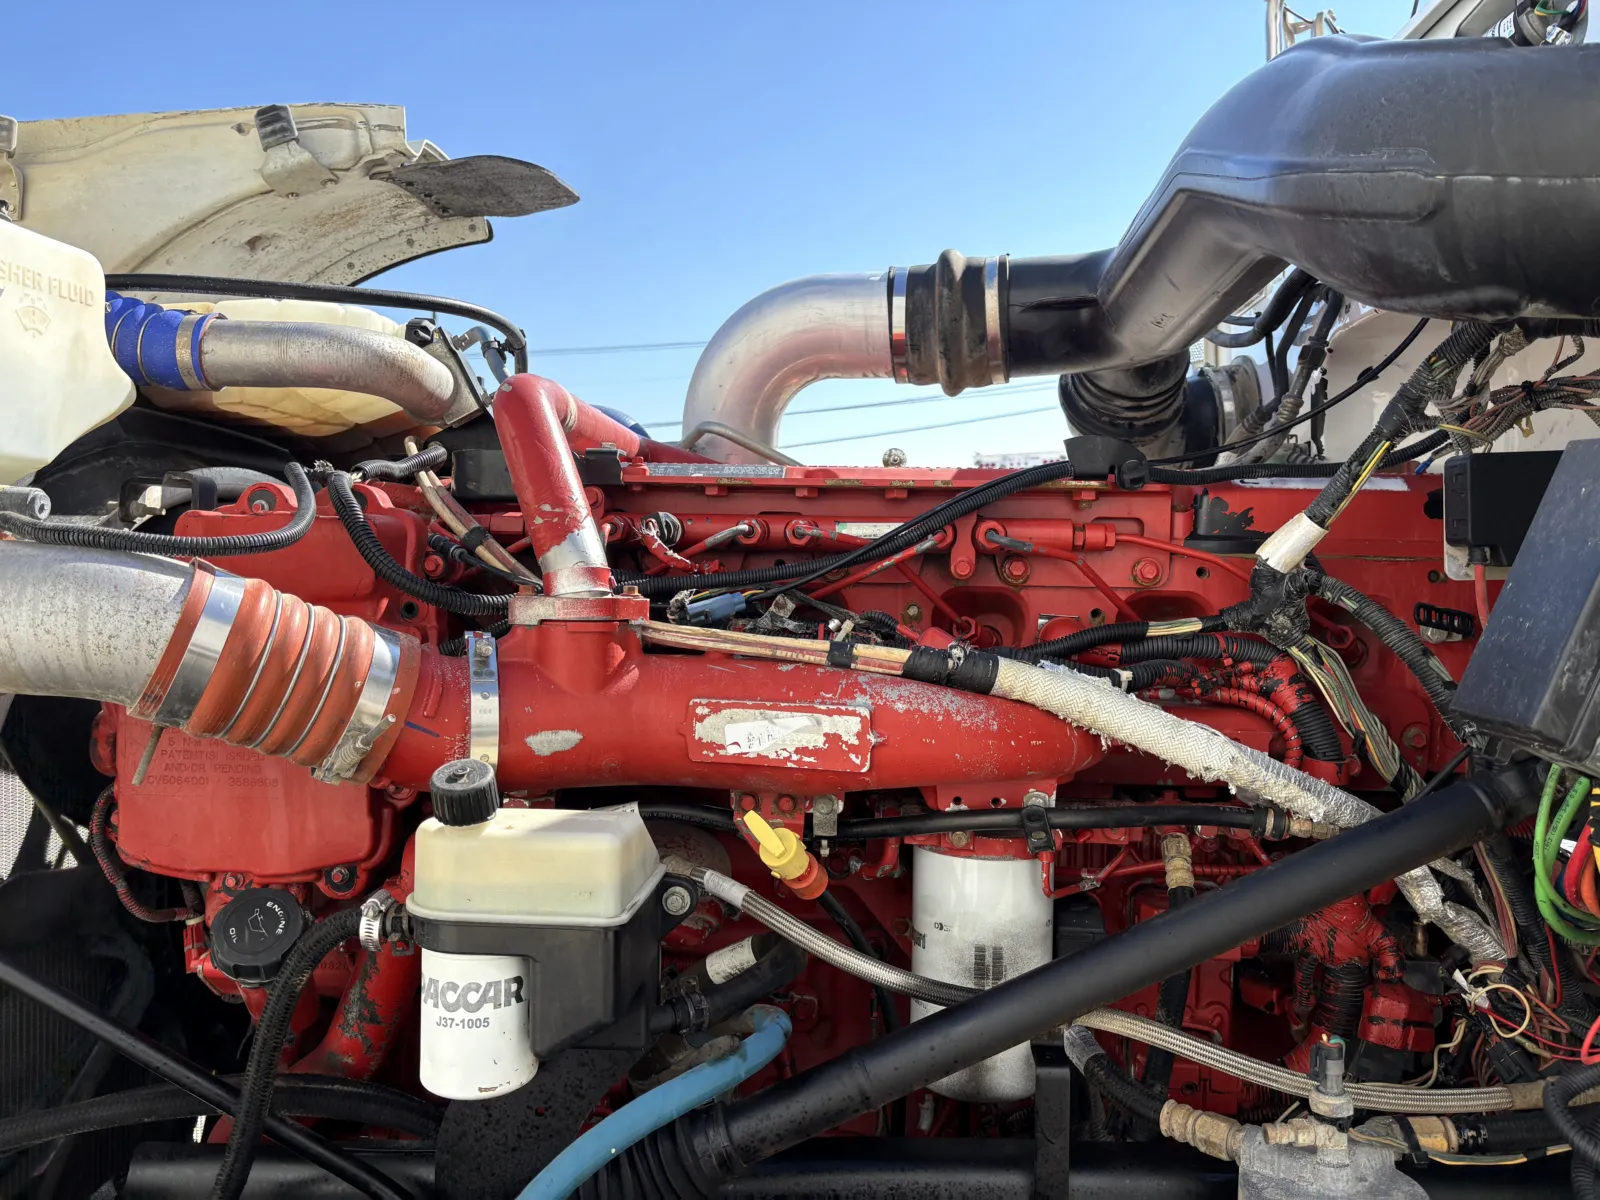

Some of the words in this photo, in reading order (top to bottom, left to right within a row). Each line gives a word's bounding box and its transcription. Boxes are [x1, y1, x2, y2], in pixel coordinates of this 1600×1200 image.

[48, 276, 95, 307] FLUID
[161, 749, 218, 760] PATENT(S)
[226, 751, 266, 761] ISSUED
[164, 762, 206, 772] AND/OR
[214, 763, 261, 774] PENDING
[266, 901, 286, 935] ENGINE
[229, 927, 239, 943] OIL
[436, 1016, 490, 1029] J37-1005
